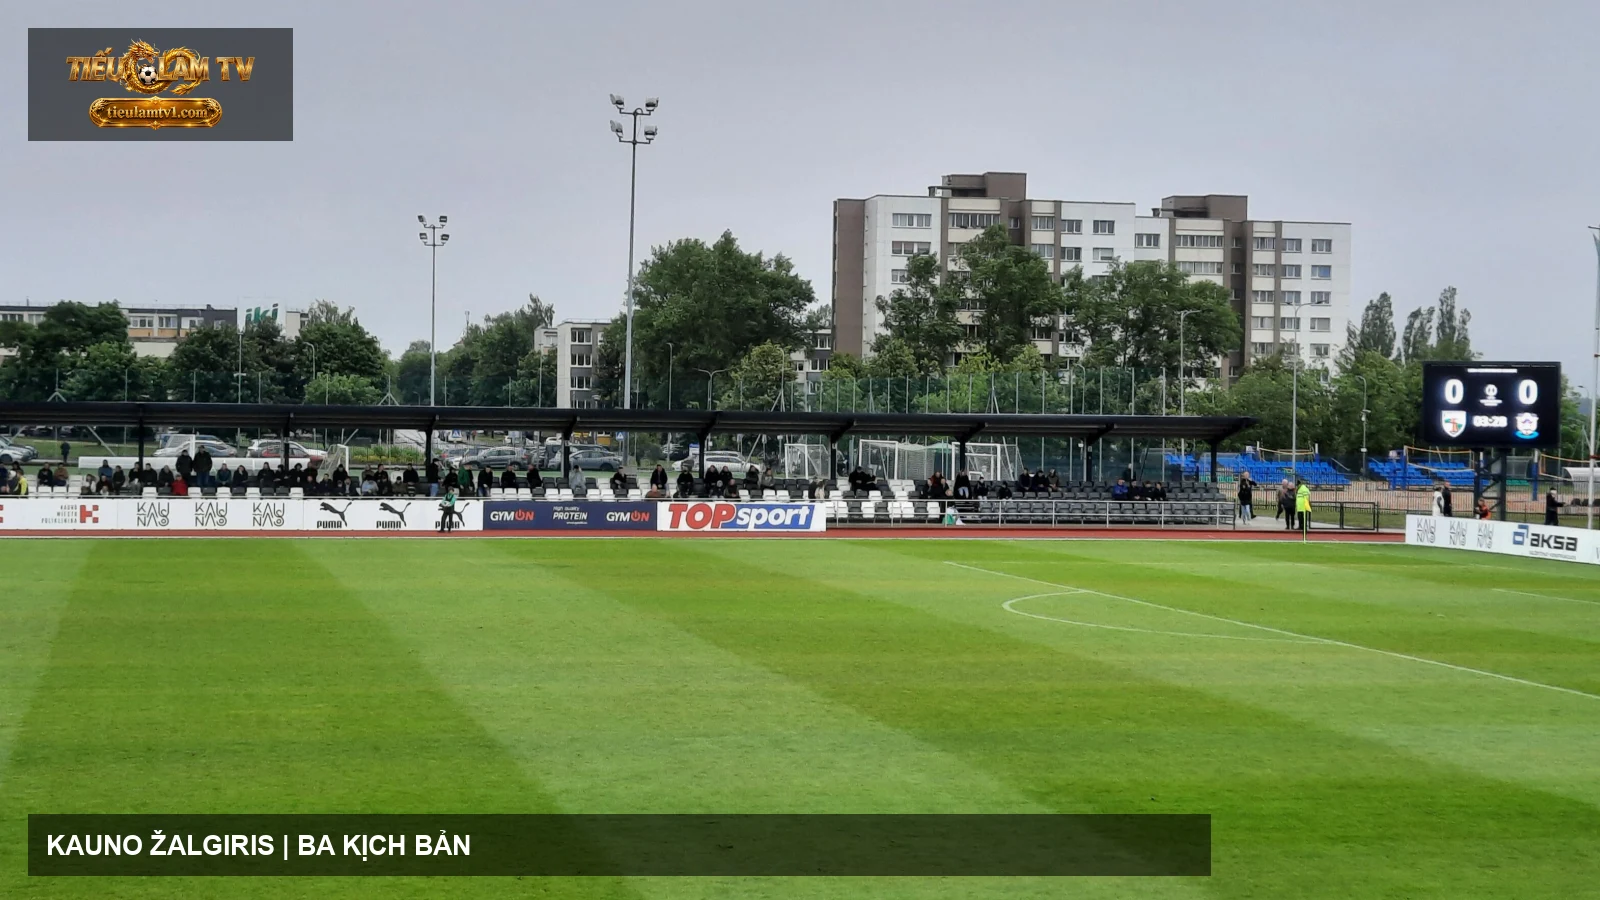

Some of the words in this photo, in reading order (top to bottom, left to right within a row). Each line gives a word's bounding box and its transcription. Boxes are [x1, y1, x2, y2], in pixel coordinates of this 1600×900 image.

[1445, 379, 1464, 404] 0
[1519, 379, 1538, 404] 0
[553, 512, 588, 520] PROTEIN
[317, 520, 343, 529] PUMA
[376, 520, 402, 529] PUMA
[1530, 533, 1578, 552] aksa
